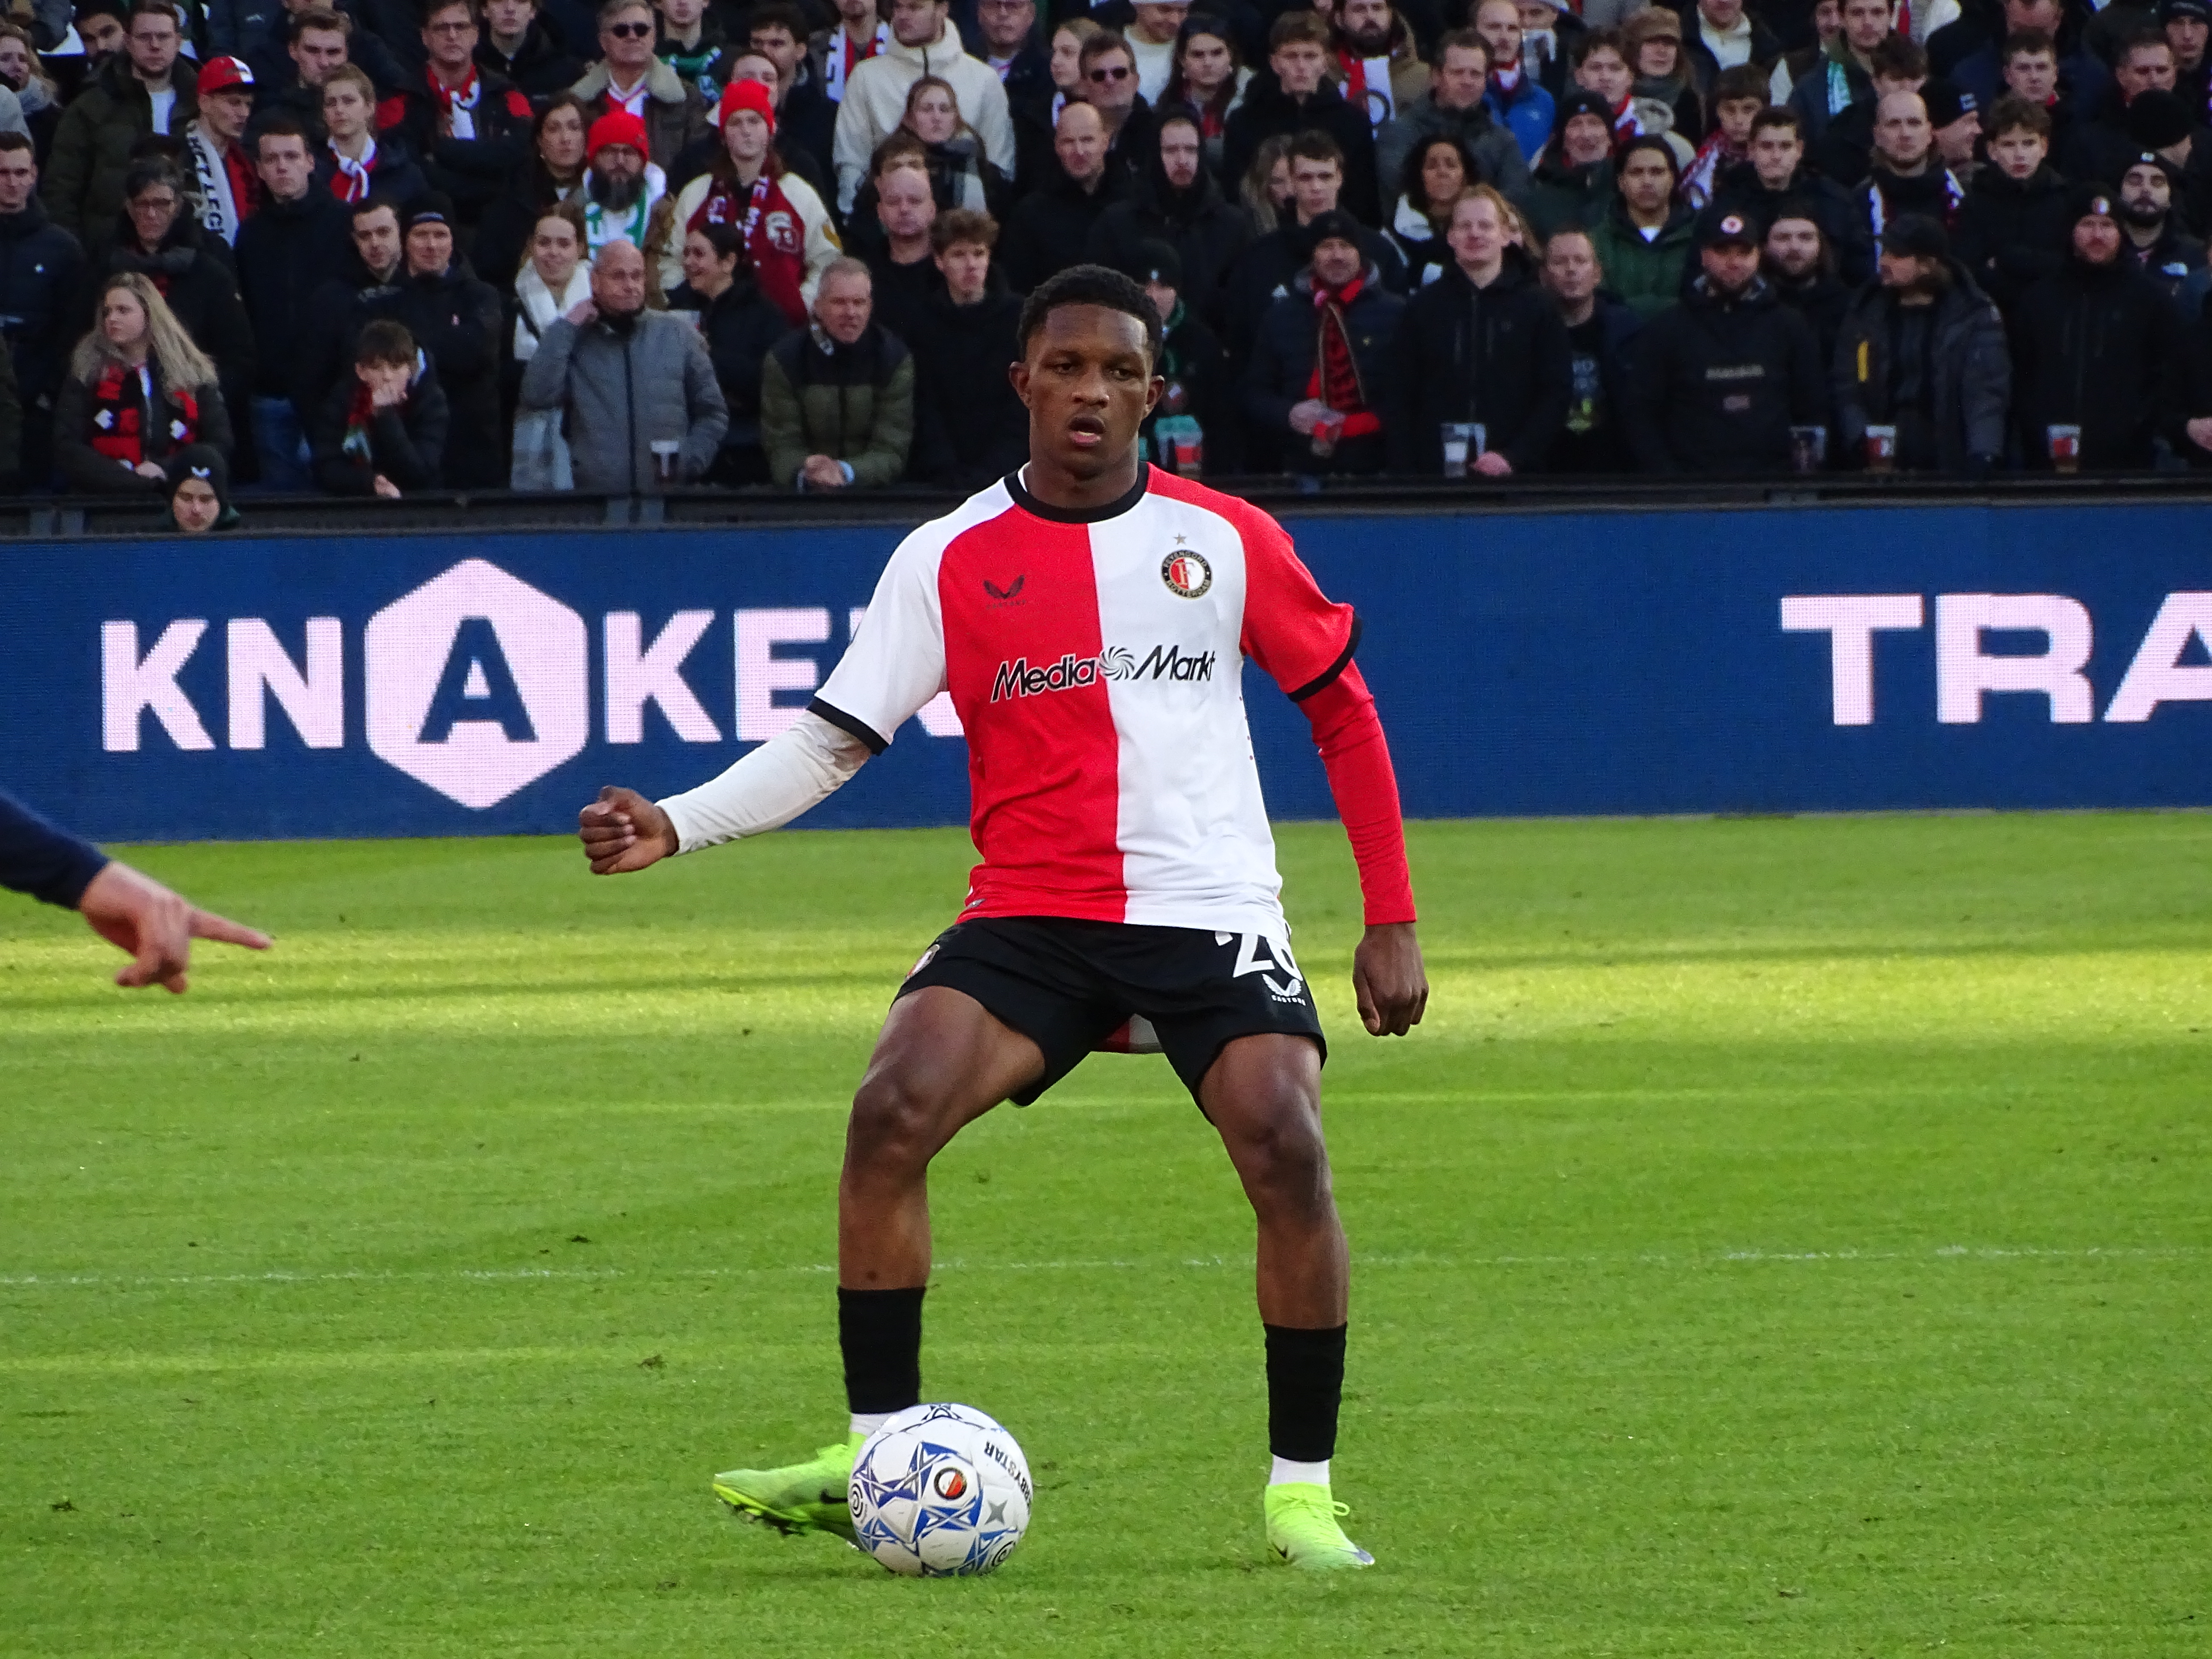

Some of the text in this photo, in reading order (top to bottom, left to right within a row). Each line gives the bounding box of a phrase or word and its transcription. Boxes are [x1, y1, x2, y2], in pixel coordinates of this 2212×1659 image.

[101, 606, 964, 752] KNAKE
[990, 644, 1216, 703] Media Markt
[1780, 591, 2212, 726] TRA
